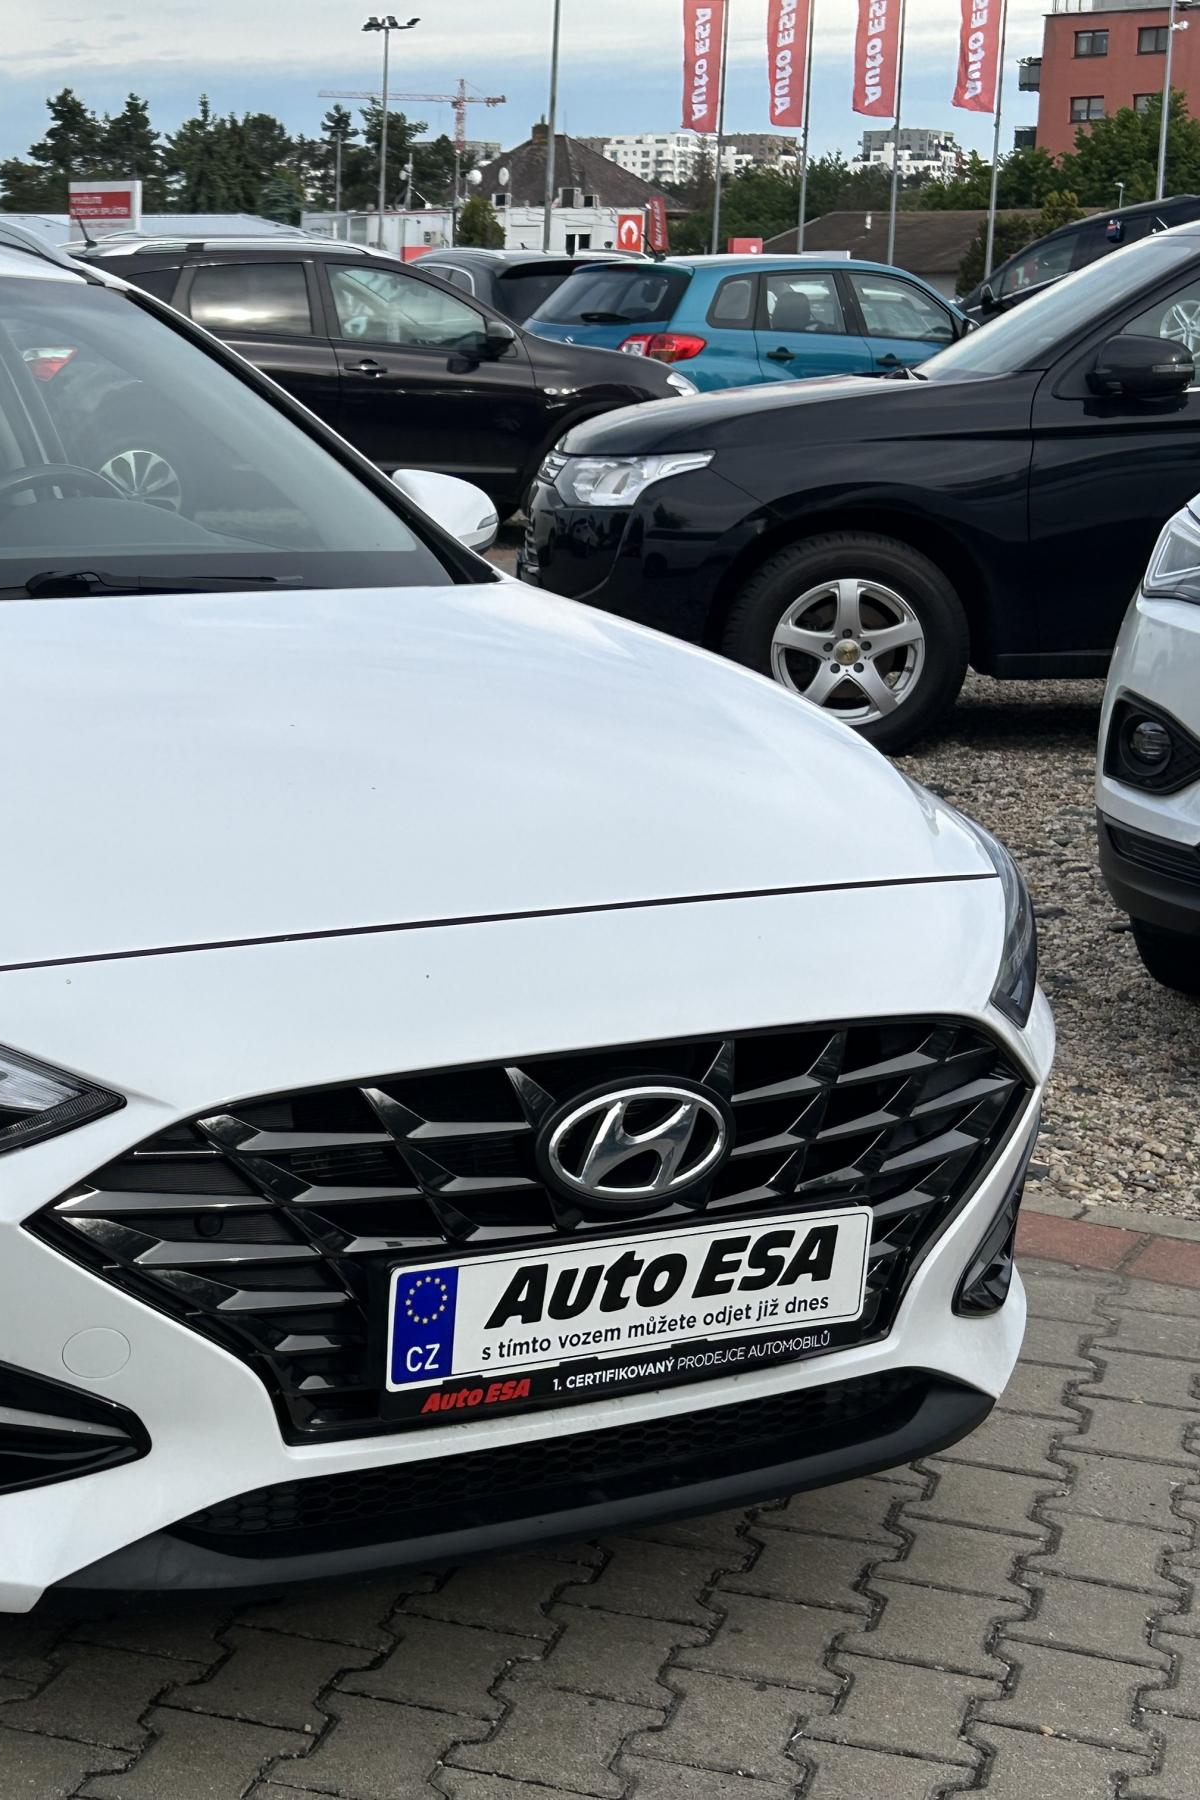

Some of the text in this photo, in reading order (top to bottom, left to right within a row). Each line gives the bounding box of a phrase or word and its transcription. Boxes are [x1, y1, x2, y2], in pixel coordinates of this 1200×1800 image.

[484, 1225, 839, 1330] Auto ESA
[406, 1344, 440, 1373] CZ
[482, 1296, 830, 1361] s tímto vozem můžete odjet již dnes
[553, 1330, 831, 1391] 1. CERTIFIKOVANÝ PRODEJCE AUTOMOBILŮ
[420, 1378, 532, 1414] Auto ESA
